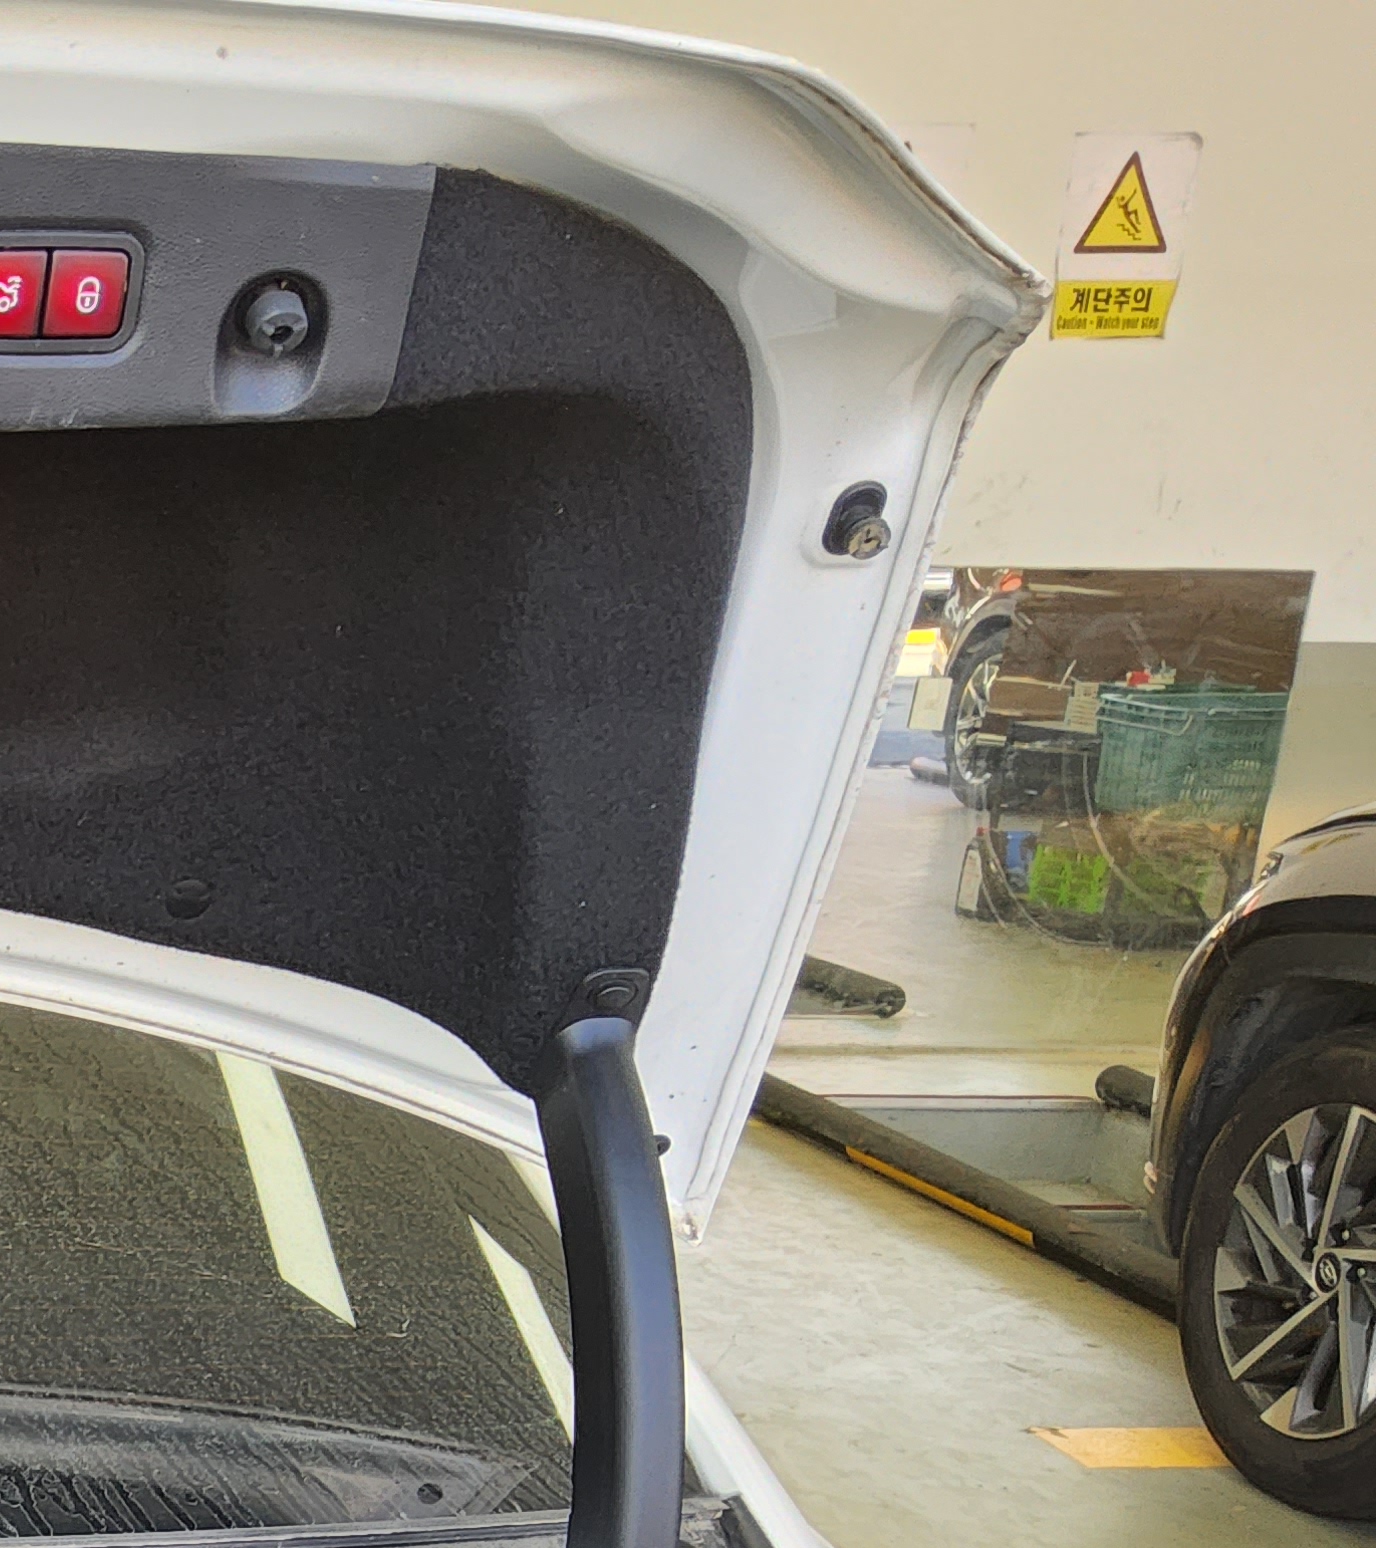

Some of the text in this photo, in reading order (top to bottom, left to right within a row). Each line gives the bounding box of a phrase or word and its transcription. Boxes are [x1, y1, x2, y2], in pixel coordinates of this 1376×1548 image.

[1069, 287, 1153, 313] 계단주의
[1056, 315, 1088, 330] Caution
[1096, 315, 1121, 330] Watch
[1141, 316, 1160, 330] step
